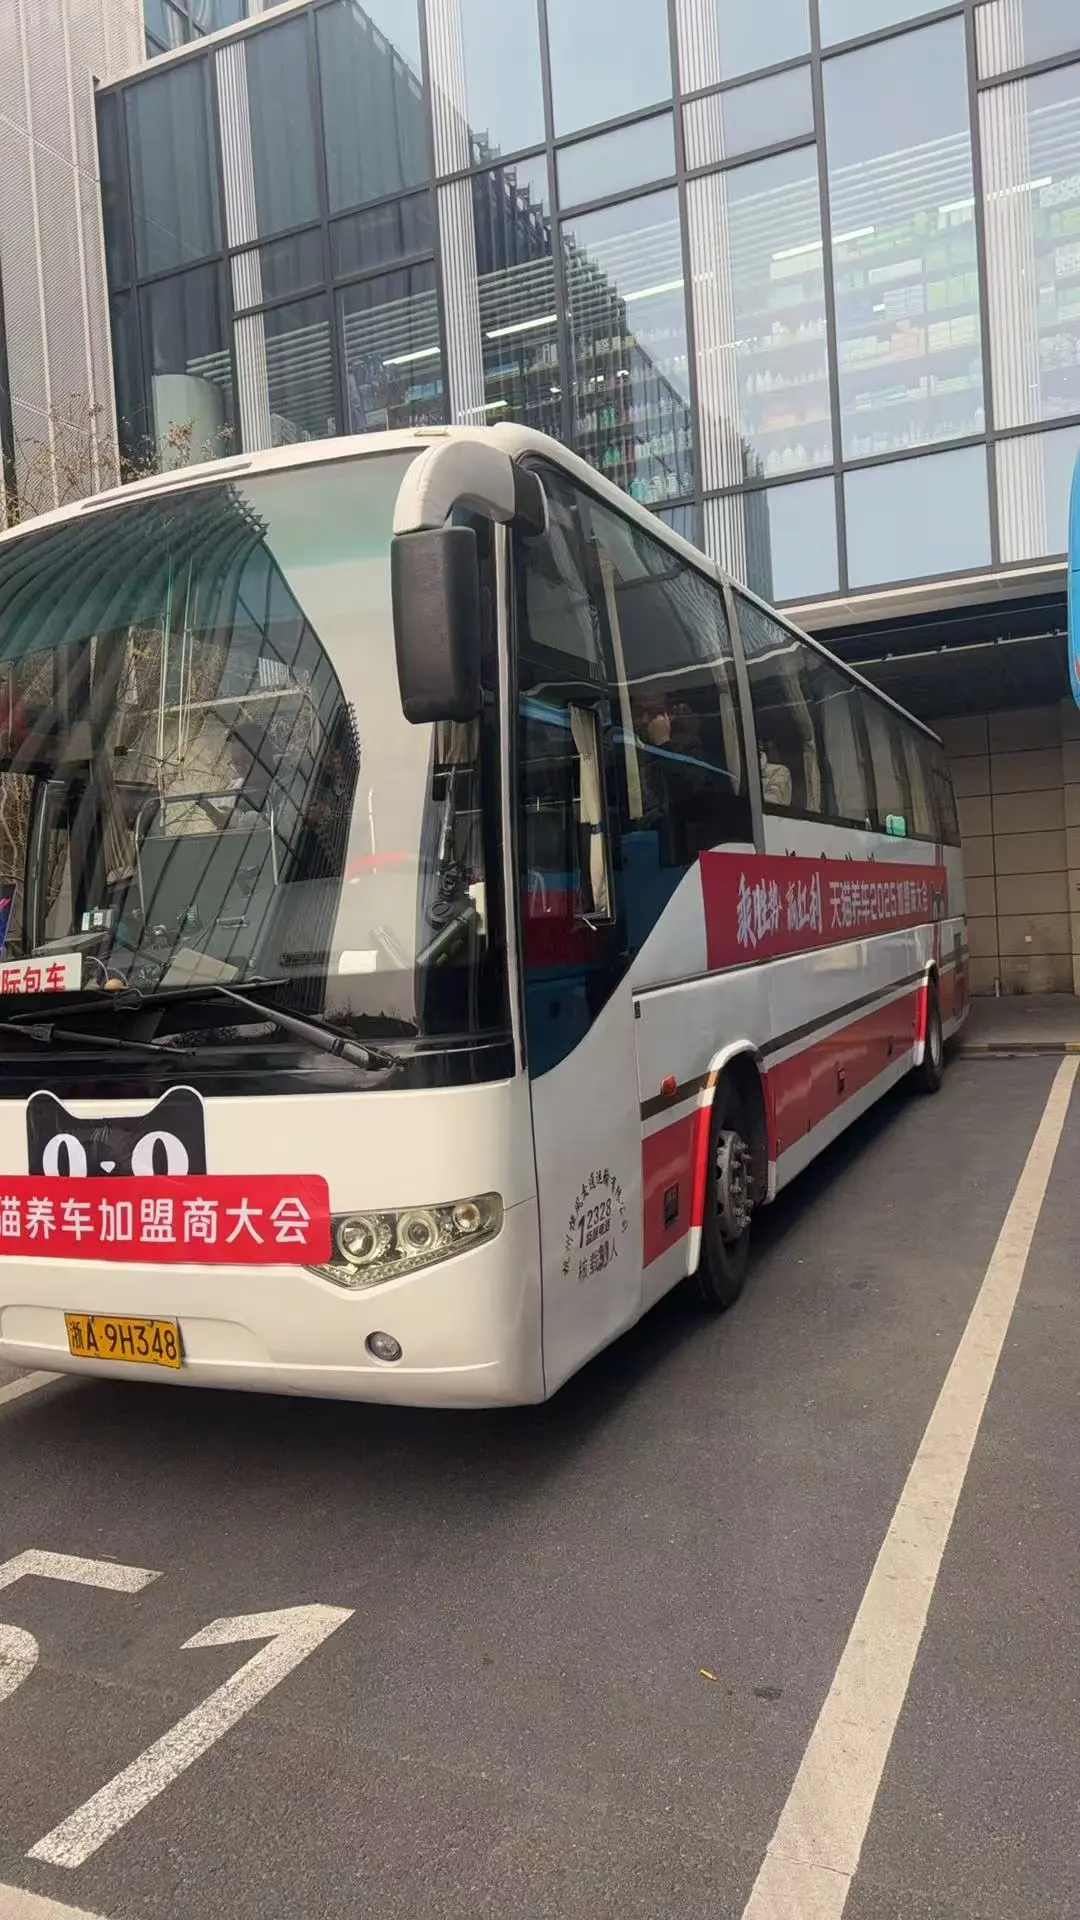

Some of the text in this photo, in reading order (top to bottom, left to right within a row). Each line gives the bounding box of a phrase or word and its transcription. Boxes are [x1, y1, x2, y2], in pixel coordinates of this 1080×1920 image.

[1, 962, 66, 995] 际包车
[0, 1195, 311, 1245] 猫养车加盟商大会
[577, 1198, 612, 1249] 12328
